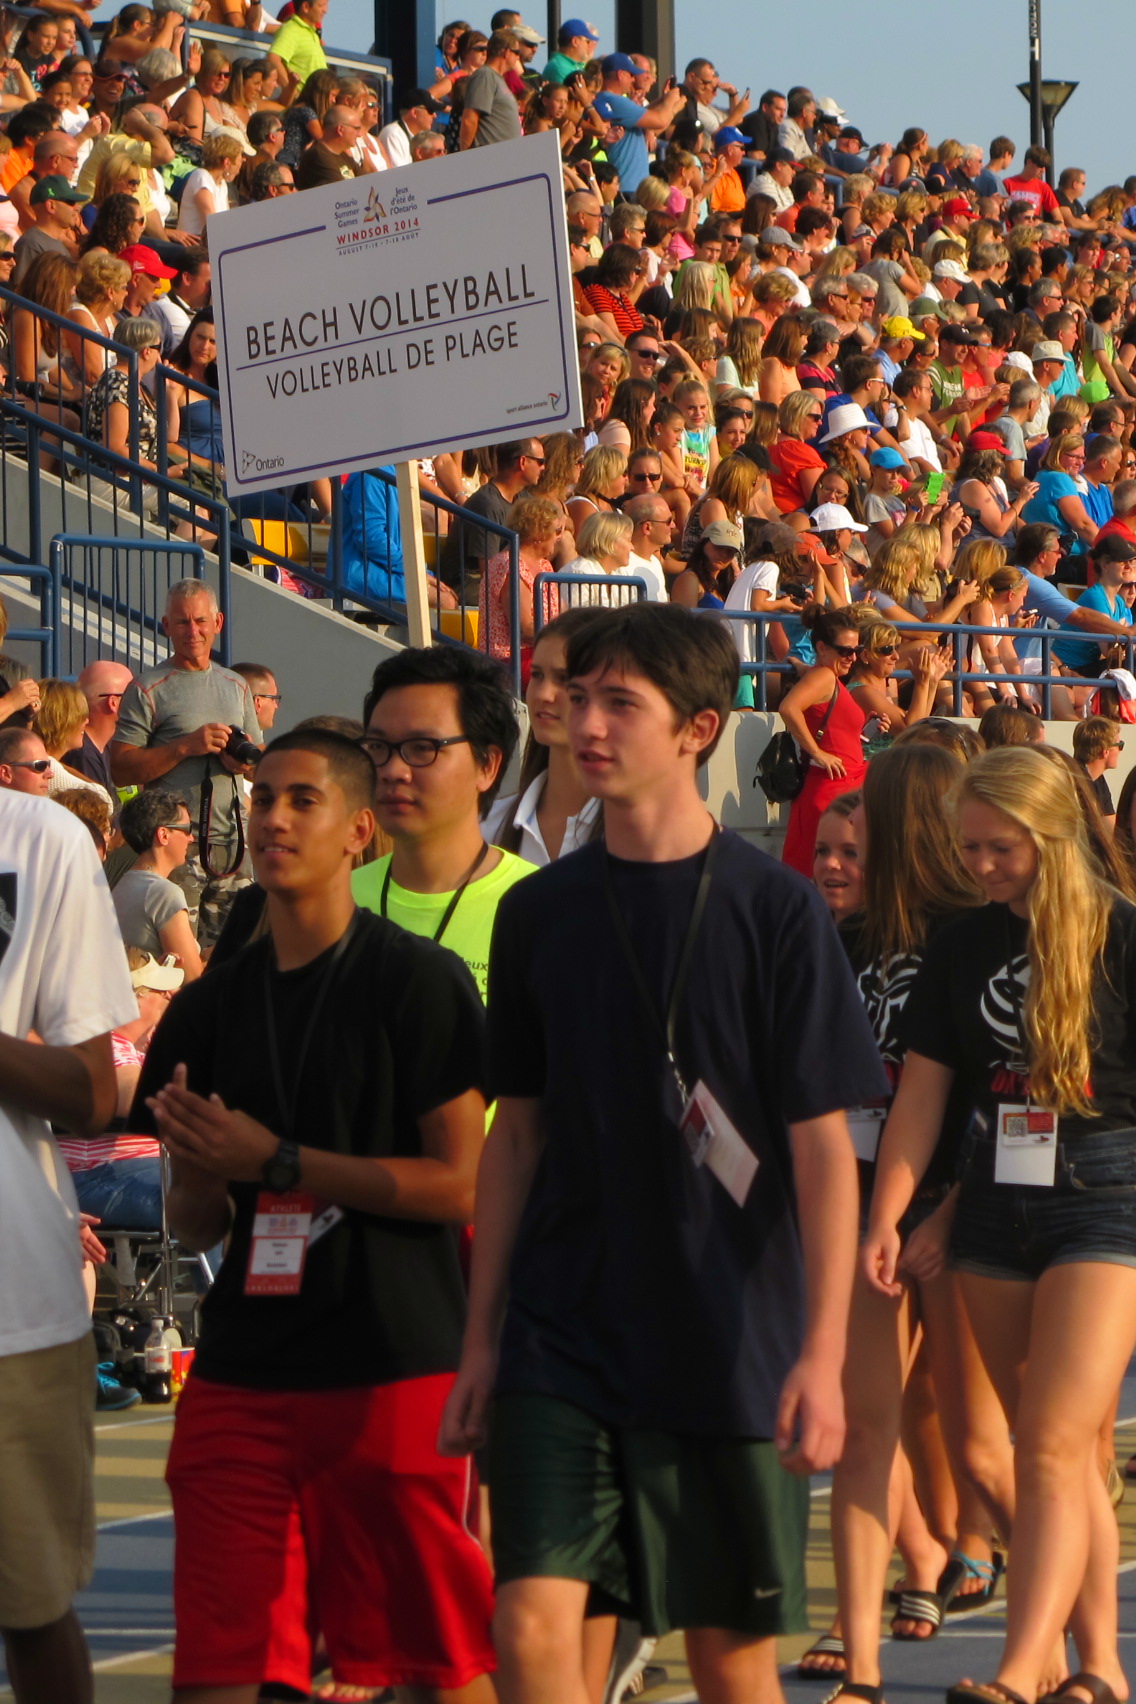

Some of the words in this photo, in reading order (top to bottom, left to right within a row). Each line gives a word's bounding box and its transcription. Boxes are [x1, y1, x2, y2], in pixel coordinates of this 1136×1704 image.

[395, 187, 409, 197] Jeux
[408, 194, 415, 202] de
[335, 198, 358, 210] Ontario
[390, 203, 418, 216] l'Ontario
[335, 209, 360, 219] Summer
[337, 219, 358, 228] Games
[337, 225, 389, 244] WINDSOR
[394, 217, 419, 232] 2014
[338, 245, 363, 256] AUGUST
[246, 307, 339, 360] BEACH
[348, 263, 536, 335] VOLLEYBALL
[266, 348, 398, 399] VOLLEYBALL
[406, 339, 435, 370] DE
[445, 321, 518, 362] PLAGE
[255, 455, 285, 471] Ontario
